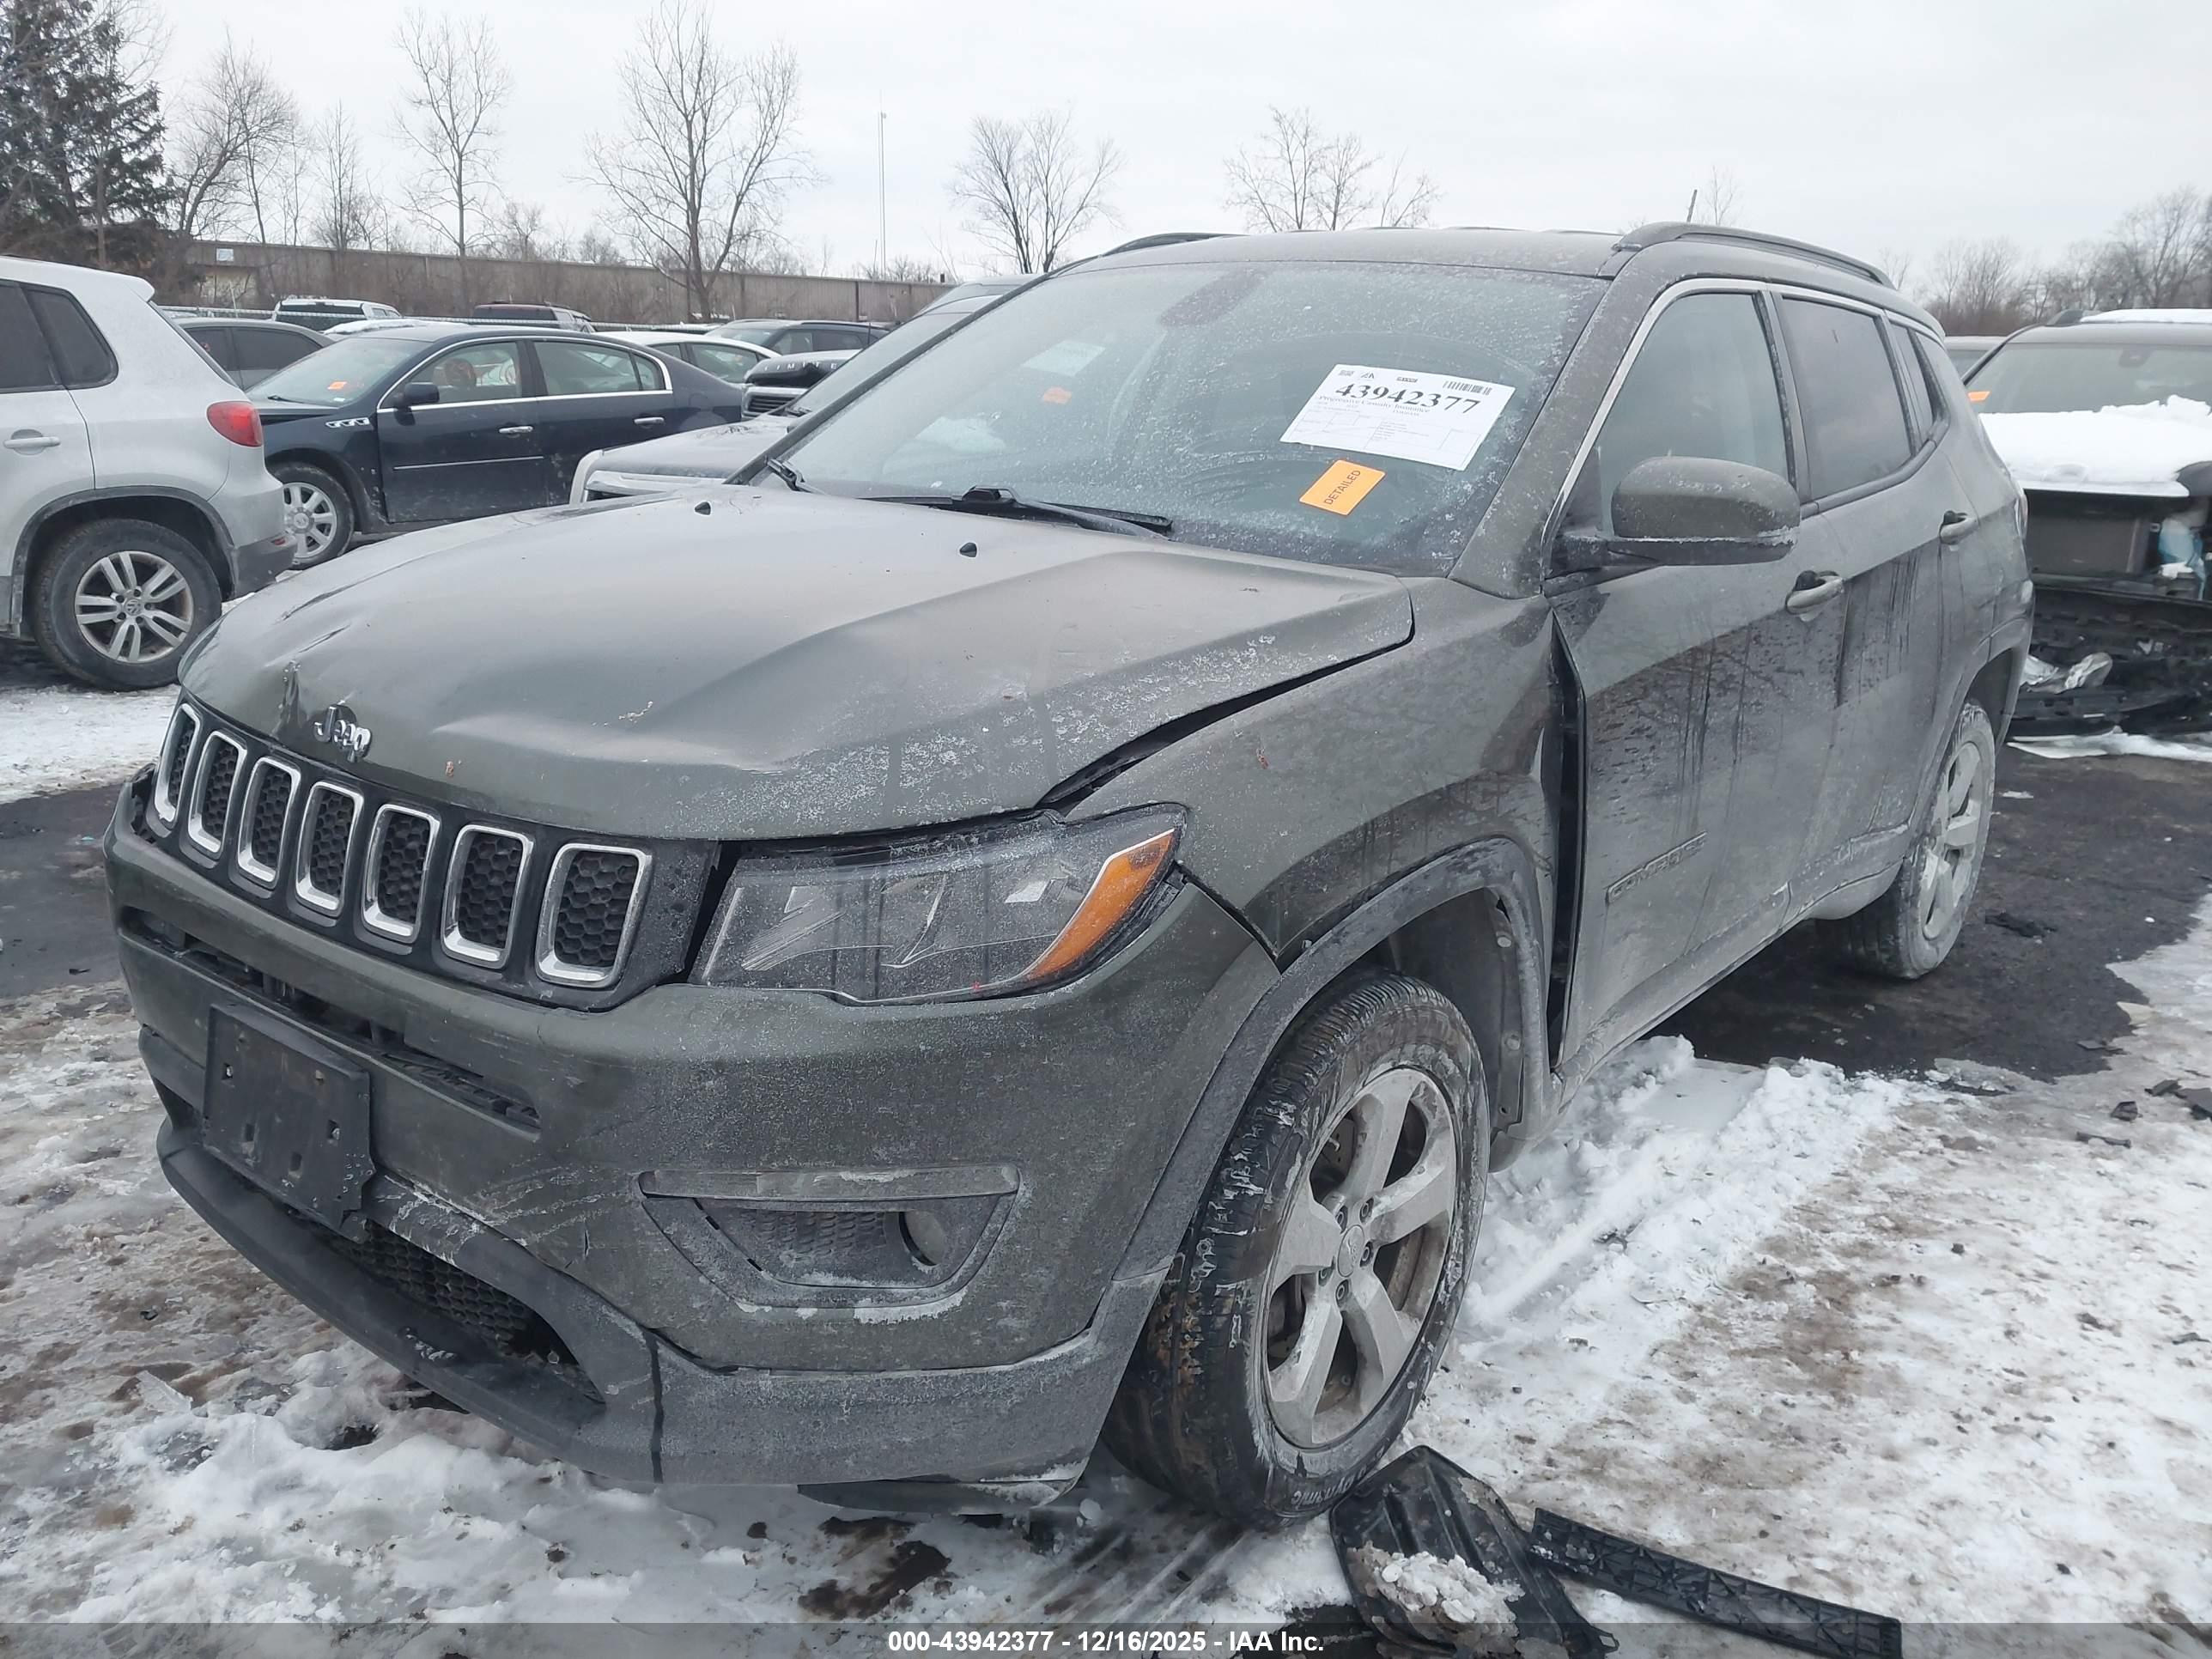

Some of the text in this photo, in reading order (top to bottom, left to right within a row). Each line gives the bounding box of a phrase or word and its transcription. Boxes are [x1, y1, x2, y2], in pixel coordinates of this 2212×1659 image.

[1335, 383, 1481, 414] 43942377
[1324, 470, 1361, 505] DETAILED
[314, 706, 371, 763] Jeep
